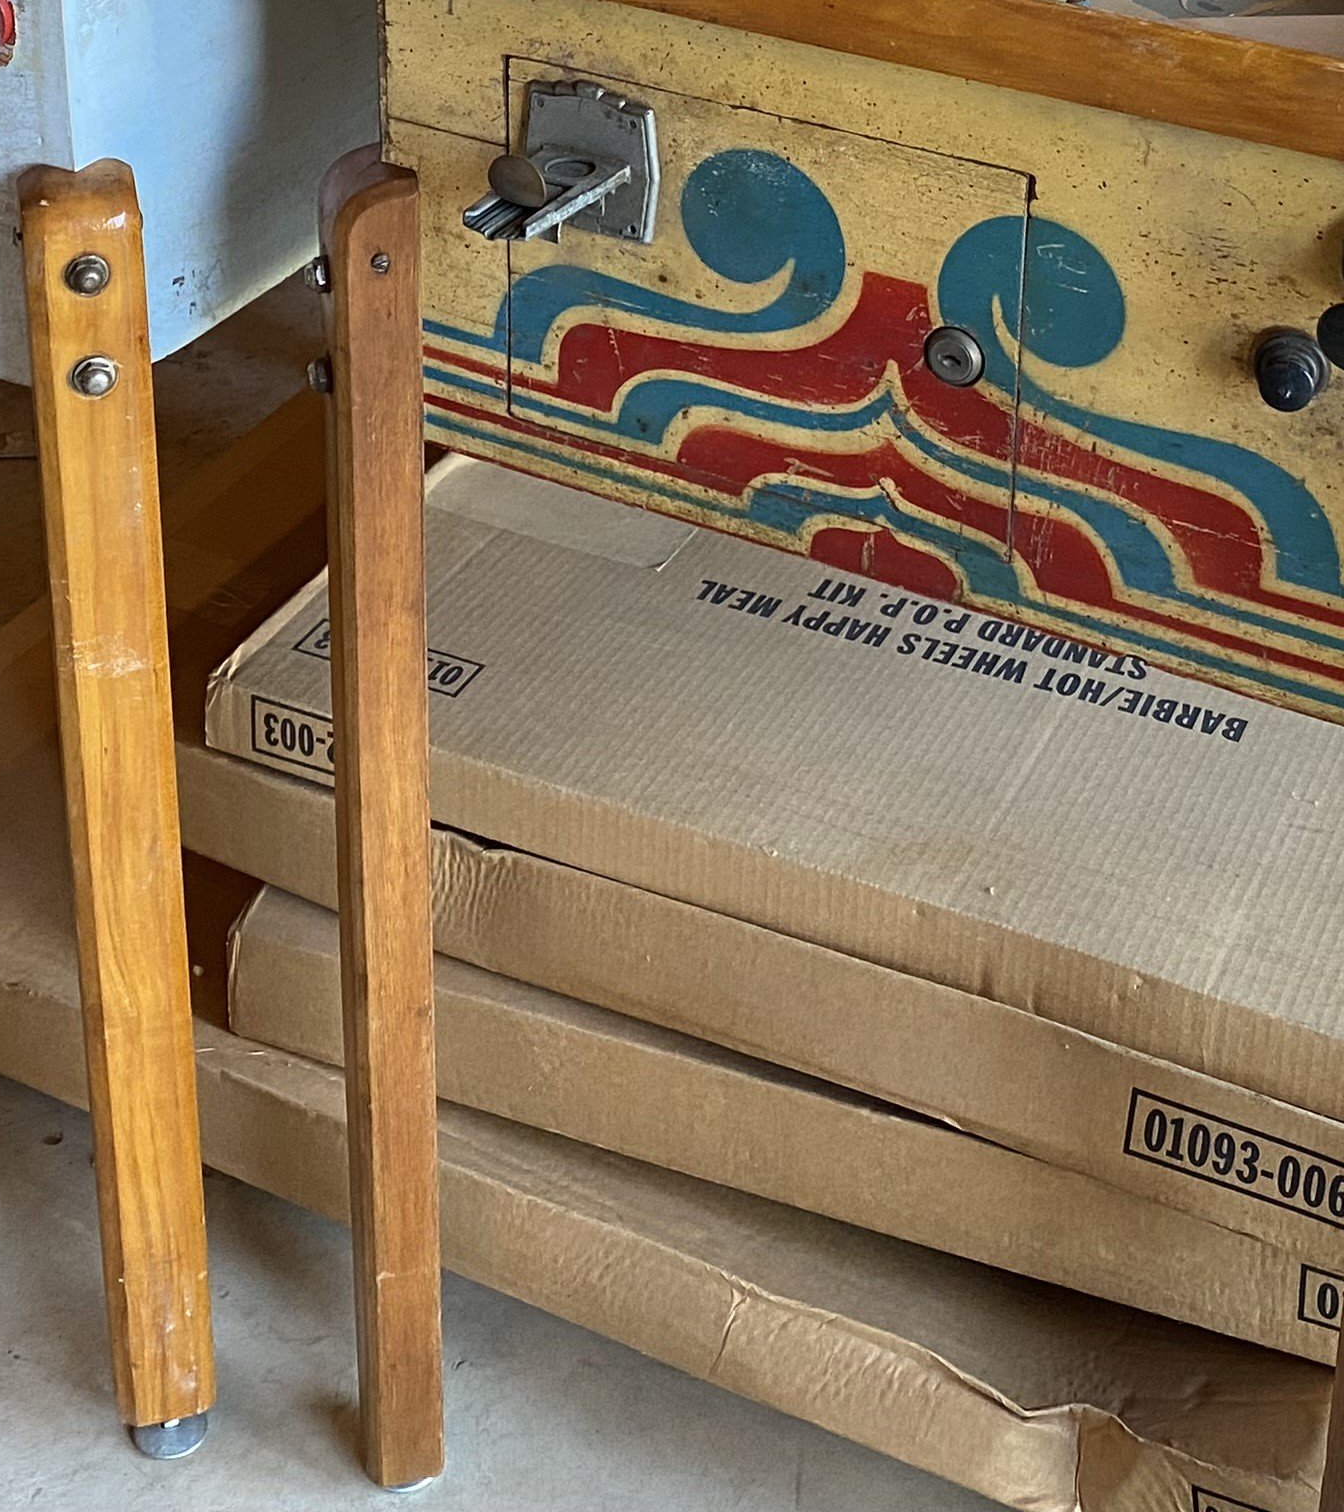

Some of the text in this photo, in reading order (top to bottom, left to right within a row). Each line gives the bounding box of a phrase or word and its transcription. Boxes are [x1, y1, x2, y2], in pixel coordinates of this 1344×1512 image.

[806, 577, 873, 610] KIT
[696, 577, 1251, 744] BARBIE/HOT WHEELS HAPPY MEAL
[975, 619, 1150, 682] STANDARD
